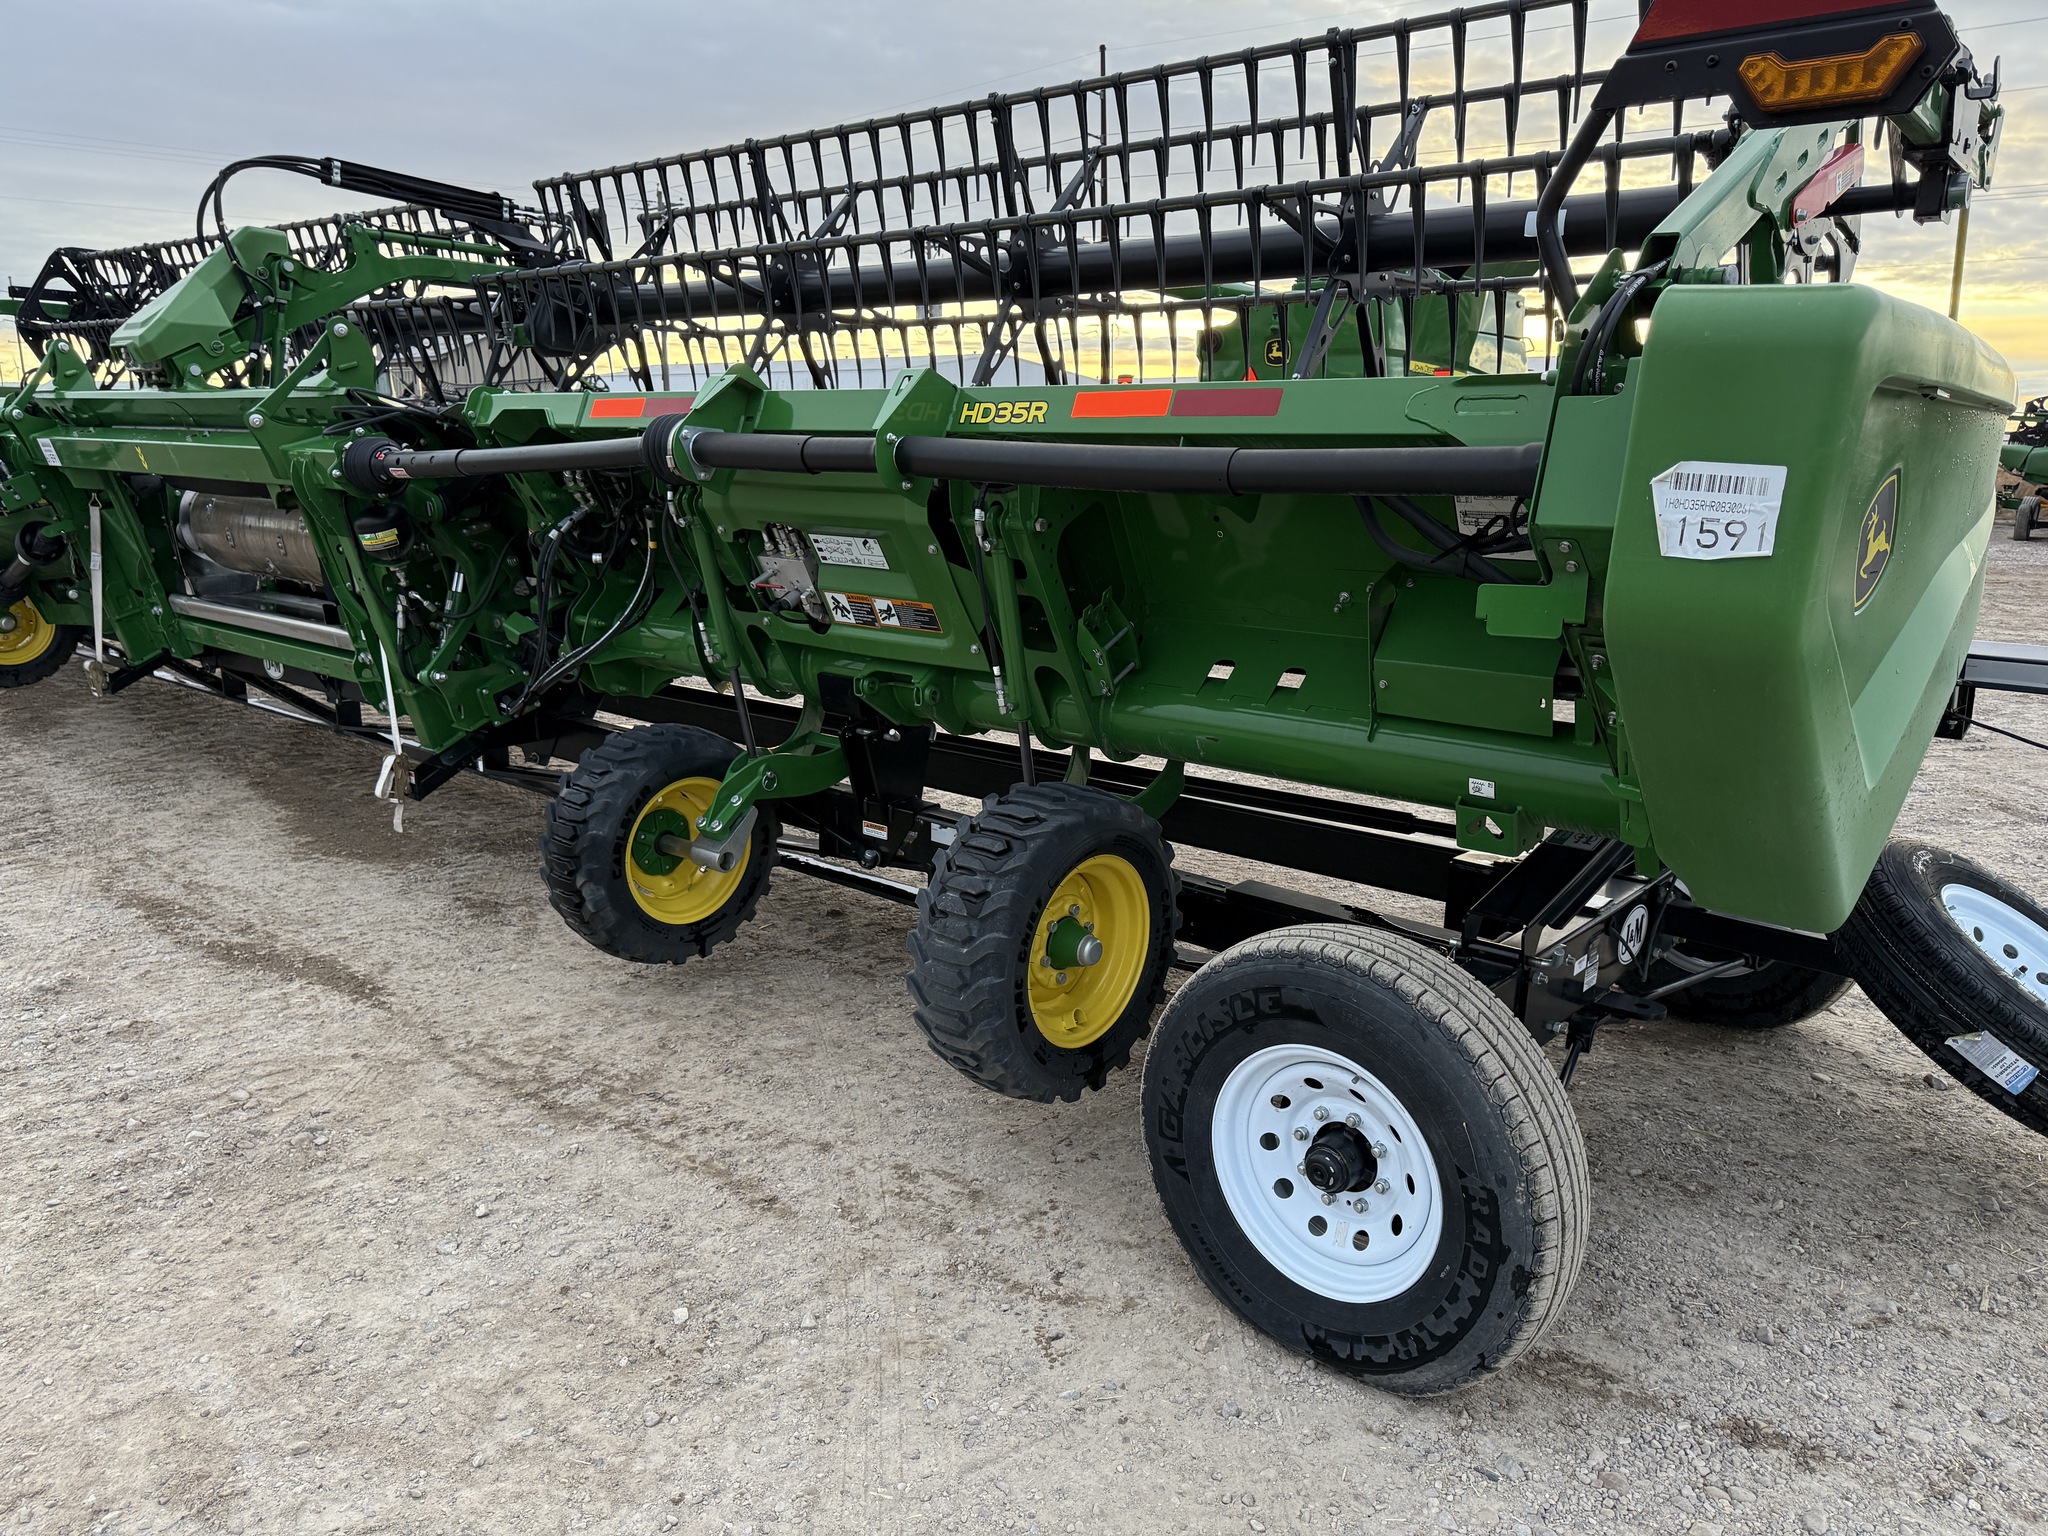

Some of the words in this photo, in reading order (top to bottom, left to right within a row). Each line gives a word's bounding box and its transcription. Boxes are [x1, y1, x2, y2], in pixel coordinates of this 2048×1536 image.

[959, 400, 1048, 425] HD35R
[1678, 515, 1767, 552] 1591
[1620, 913, 1645, 955] J&M
[1158, 986, 1283, 1145] CARLISLE
